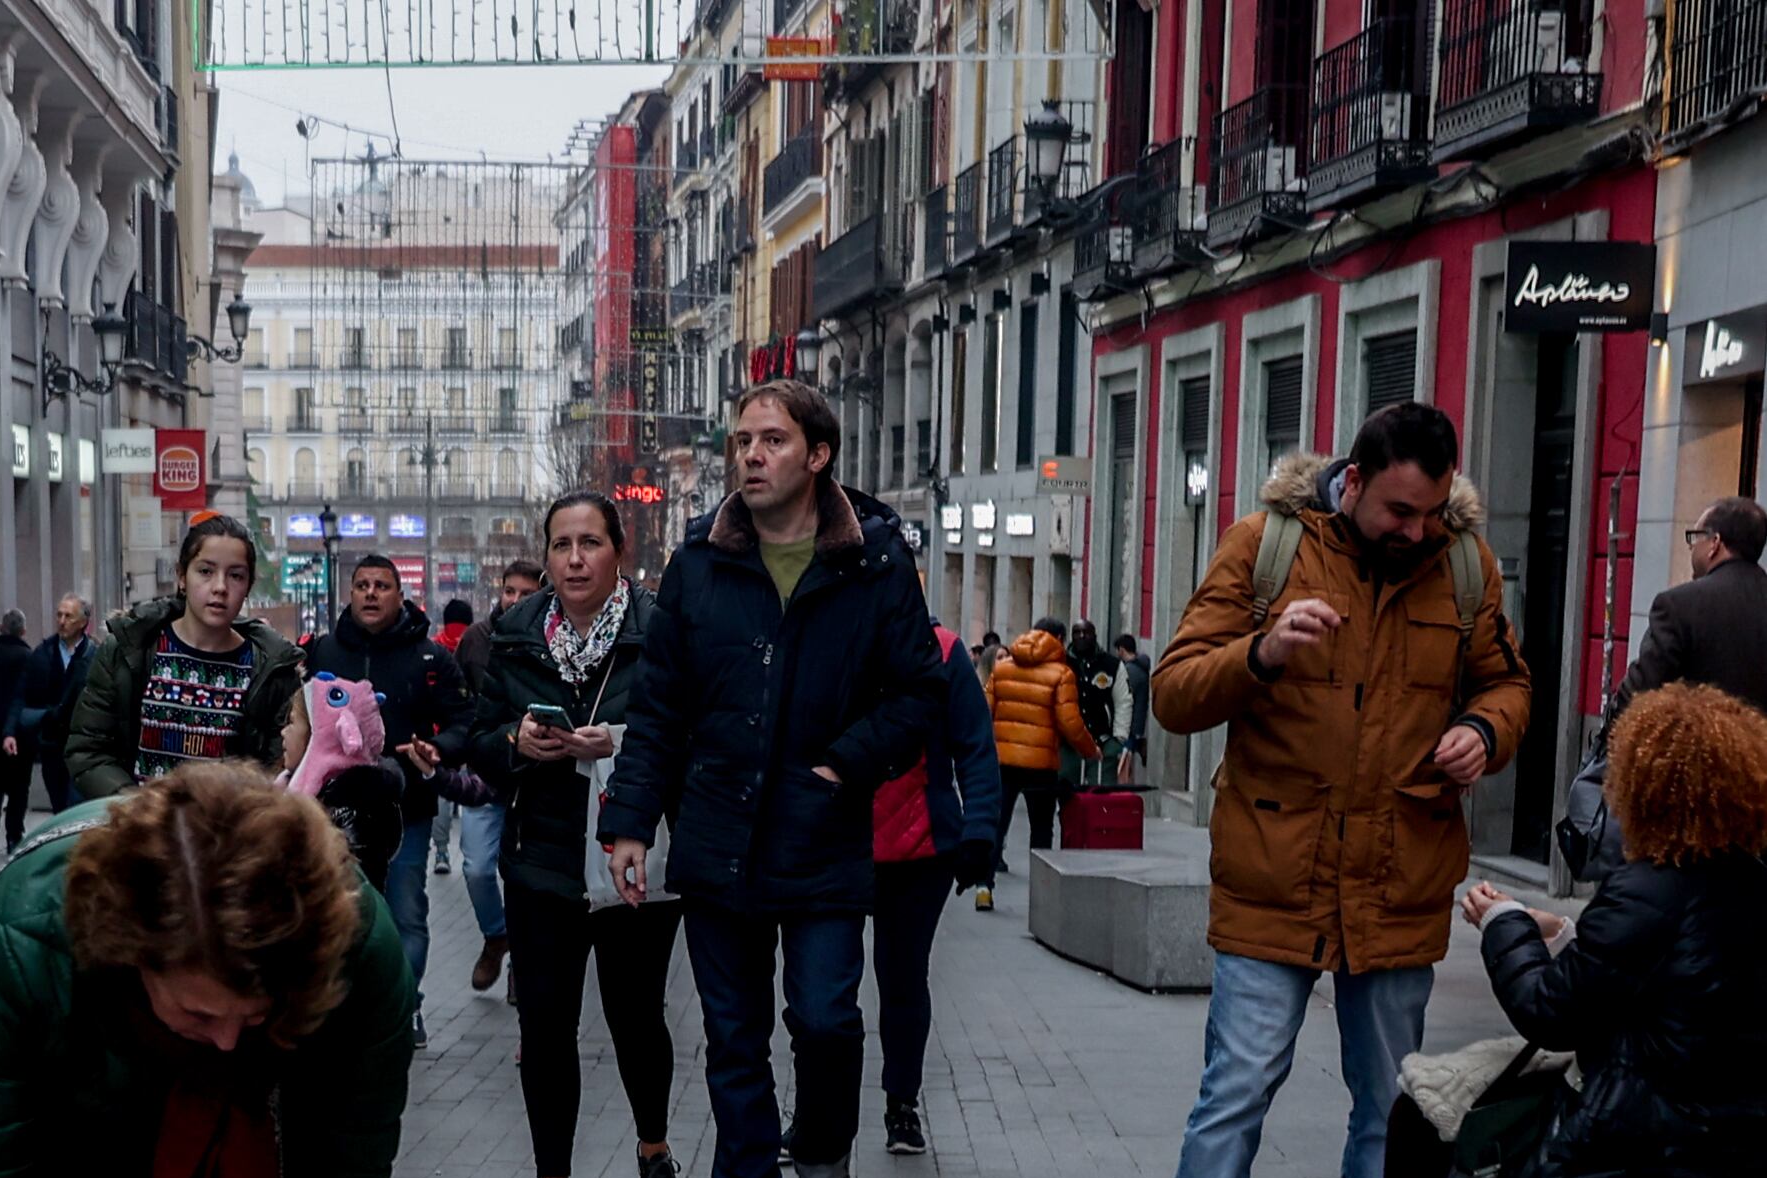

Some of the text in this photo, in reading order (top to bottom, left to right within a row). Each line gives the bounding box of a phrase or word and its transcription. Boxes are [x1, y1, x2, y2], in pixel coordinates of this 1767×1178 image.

[105, 442, 152, 458] lefties
[162, 460, 197, 471] BURGER
[162, 470, 197, 481] KING
